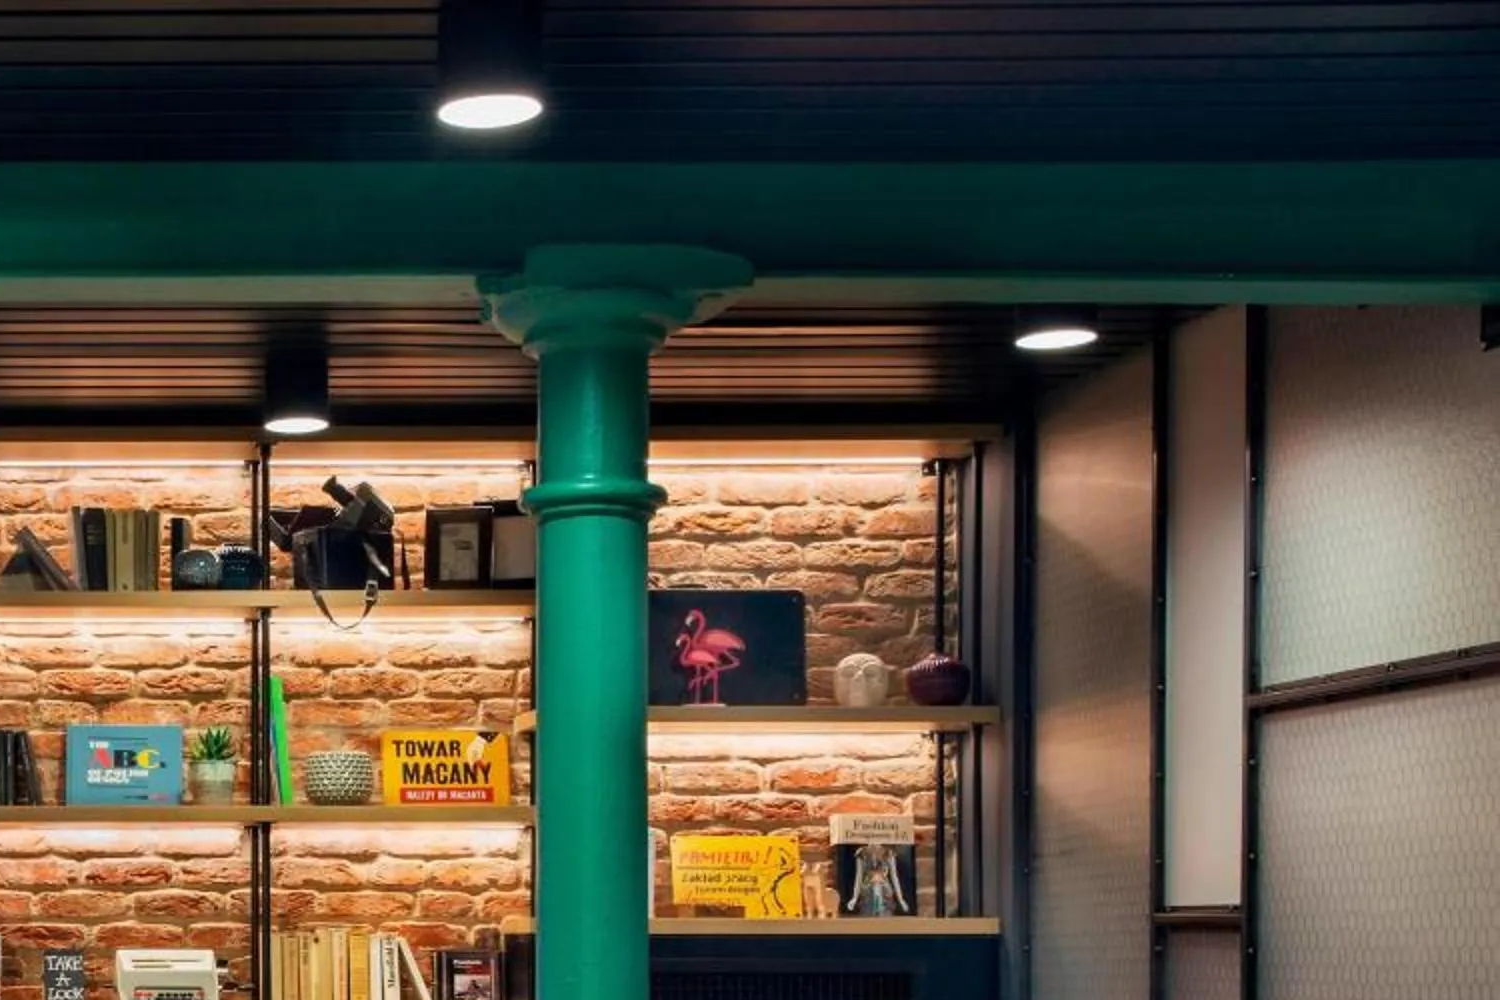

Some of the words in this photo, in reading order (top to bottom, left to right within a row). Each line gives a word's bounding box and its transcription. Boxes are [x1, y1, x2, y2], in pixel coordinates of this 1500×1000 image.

[392, 740, 461, 757] TOWAR
[402, 762, 491, 785] MACANY
[46, 955, 83, 971] TAKE
[55, 973, 72, 987] A
[47, 987, 85, 1000] LOOK
